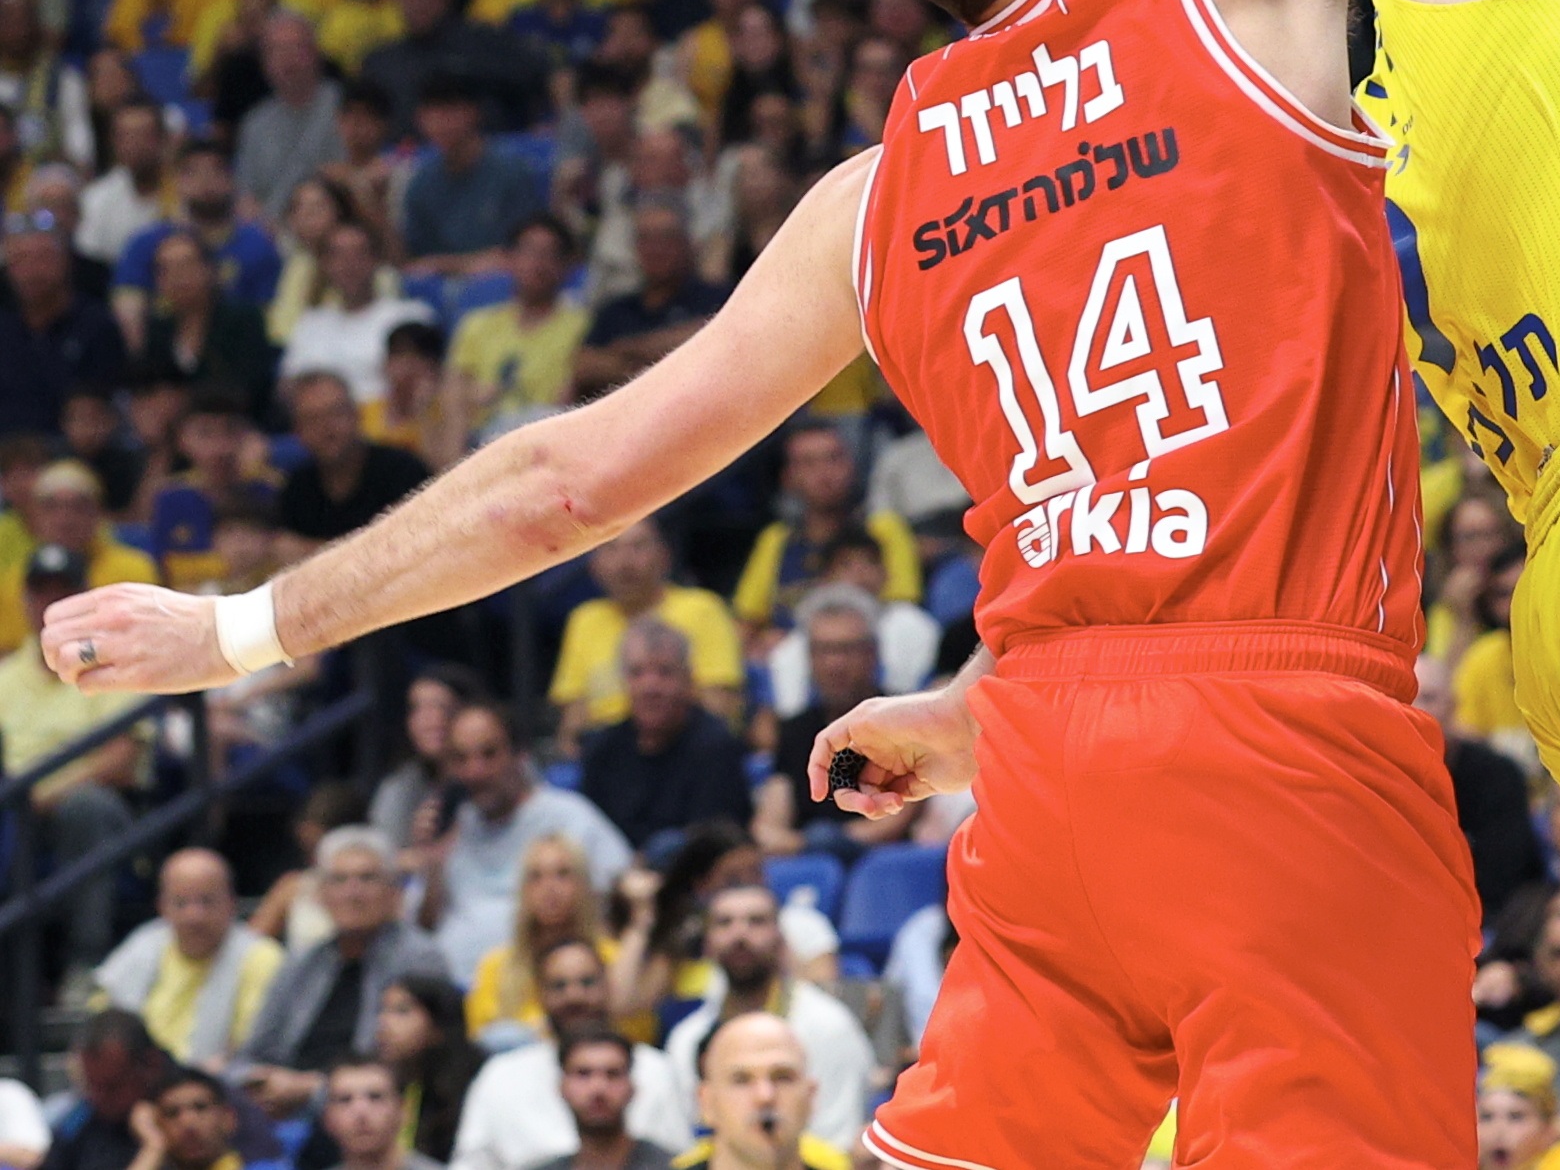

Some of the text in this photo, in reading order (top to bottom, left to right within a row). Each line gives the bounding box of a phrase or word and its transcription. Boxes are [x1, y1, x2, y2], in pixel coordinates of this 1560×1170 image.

[918, 40, 1125, 176] בלייזר
[963, 224, 1230, 505] 14
[1012, 459, 1208, 568] arkia
